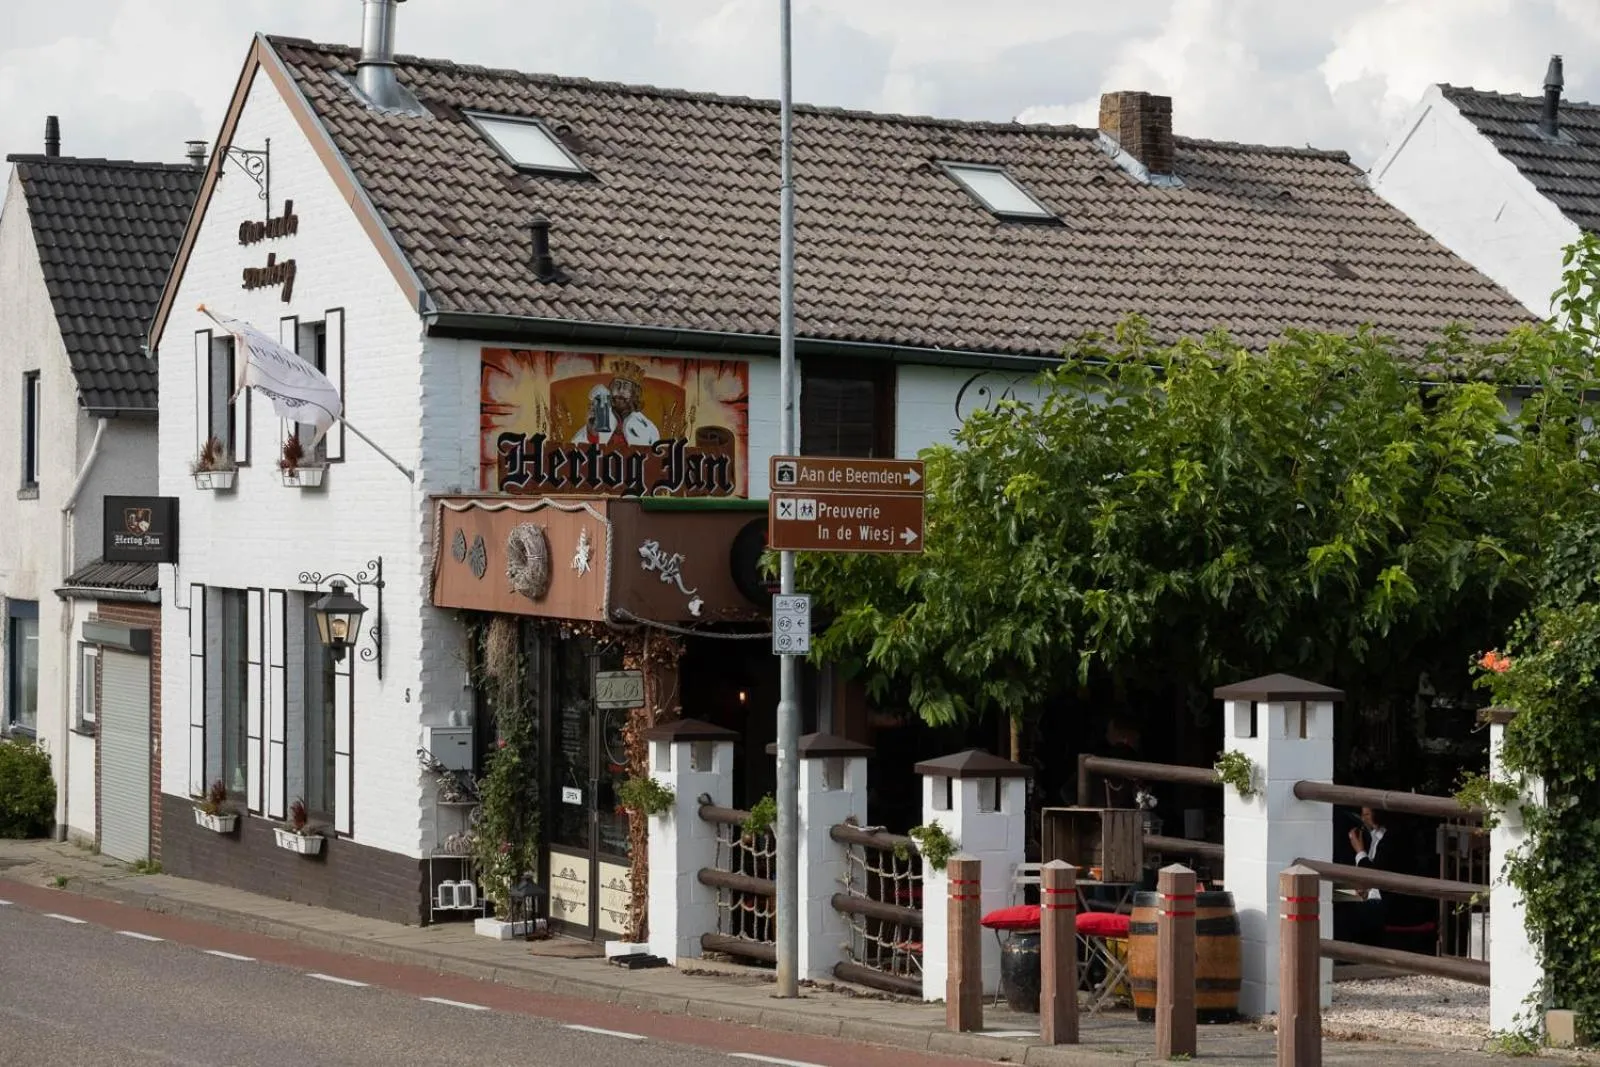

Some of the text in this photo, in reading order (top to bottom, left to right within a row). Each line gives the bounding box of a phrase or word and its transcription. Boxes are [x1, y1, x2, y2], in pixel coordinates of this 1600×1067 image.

[497, 431, 737, 497] Hertog Jan
[799, 466, 903, 485] Aan de Beemden
[818, 502, 880, 519] Preuverie
[115, 535, 160, 546] Hertog Jan
[818, 525, 895, 545] In de Wiesj
